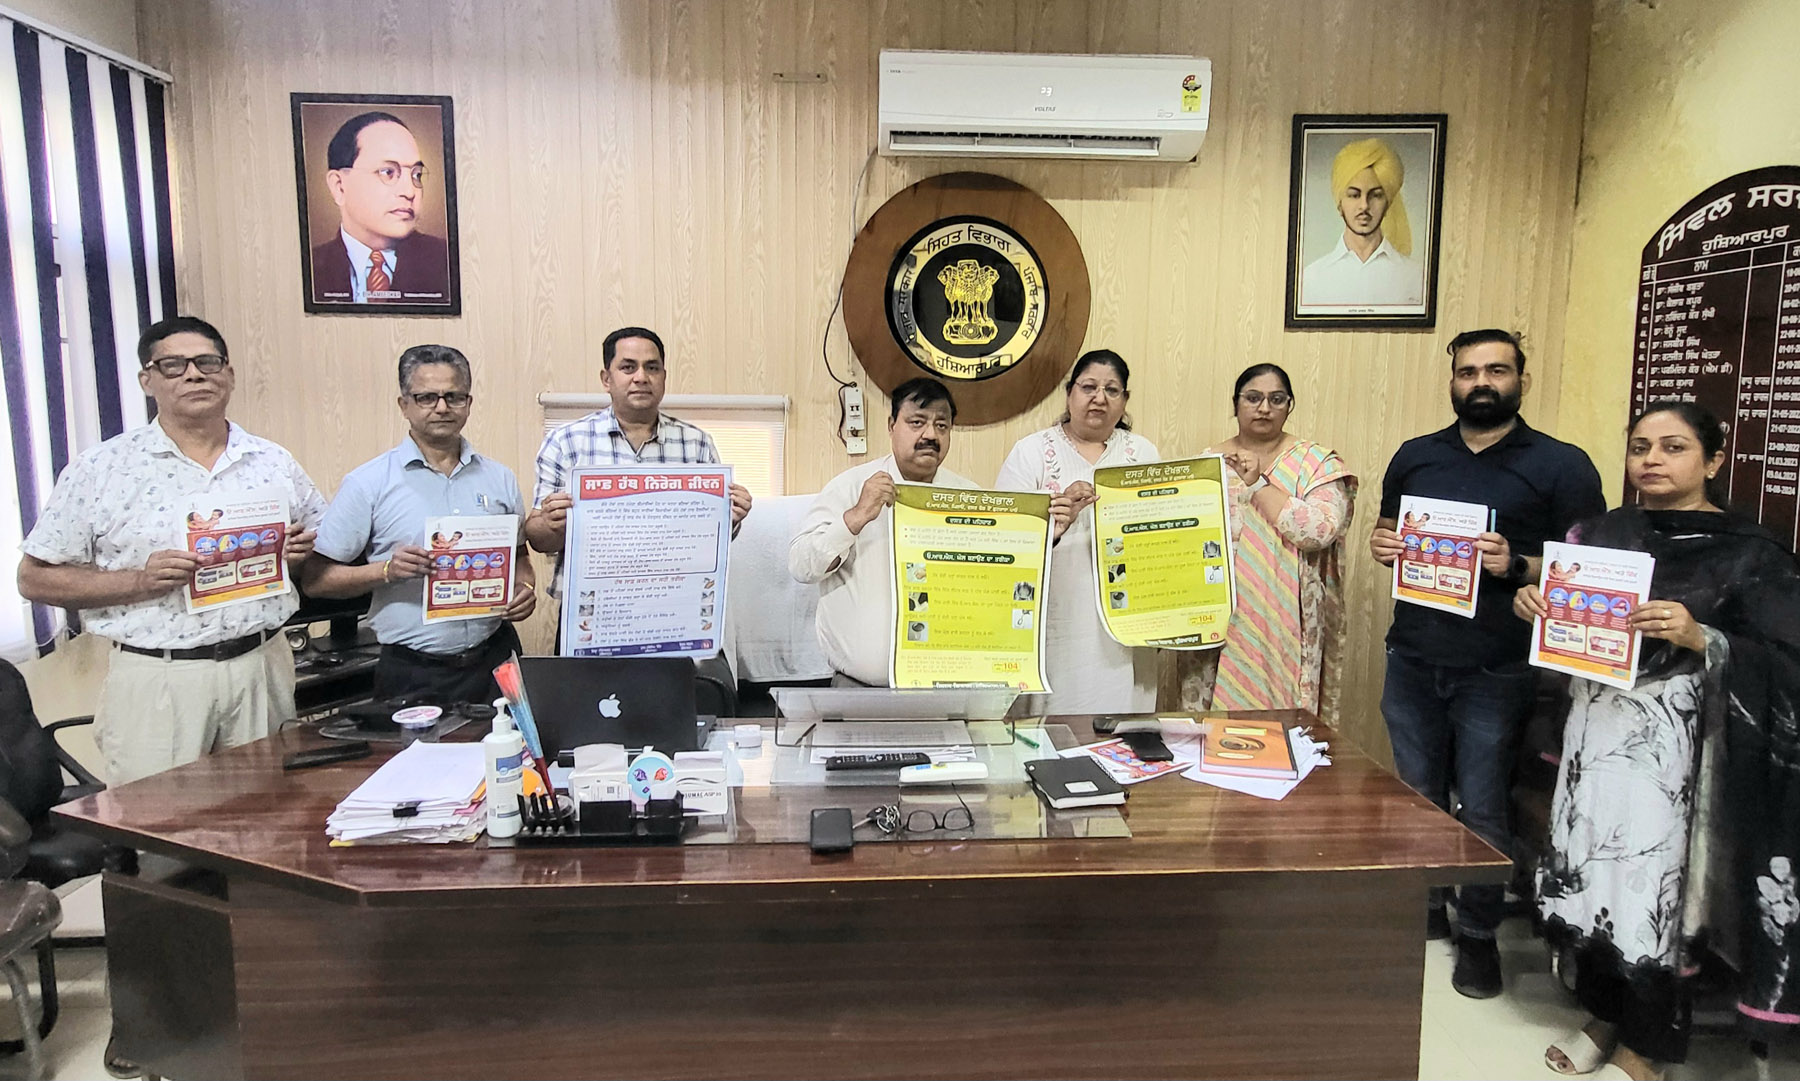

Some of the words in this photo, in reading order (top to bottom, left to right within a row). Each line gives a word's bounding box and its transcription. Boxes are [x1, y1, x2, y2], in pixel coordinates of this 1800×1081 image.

[1041, 87, 1052, 97] 23
[927, 229, 964, 255] ਸਿਹਤ
[967, 225, 1012, 253] ਵਿਭਾਗ
[1658, 193, 1736, 259] ਸਿਵਲ
[1702, 225, 1790, 255] ਹੁਸ਼ਿਆਰਪੁਰ
[1694, 260, 1709, 272] ਨਾਮ
[1023, 266, 1039, 297] ਪੰਜਾਬ
[1022, 302, 1040, 340] ਸਰਕਾਰ
[618, 476, 639, 490] ਹੱਥ
[644, 476, 683, 490] ਨਿਰੋਗ
[688, 476, 720, 490] ਜੀਵਨ
[932, 493, 956, 502] ਦਸਤ
[960, 492, 978, 504] ਵਿੱਚ
[982, 494, 1015, 506] ਦੇਖਭਾਲ
